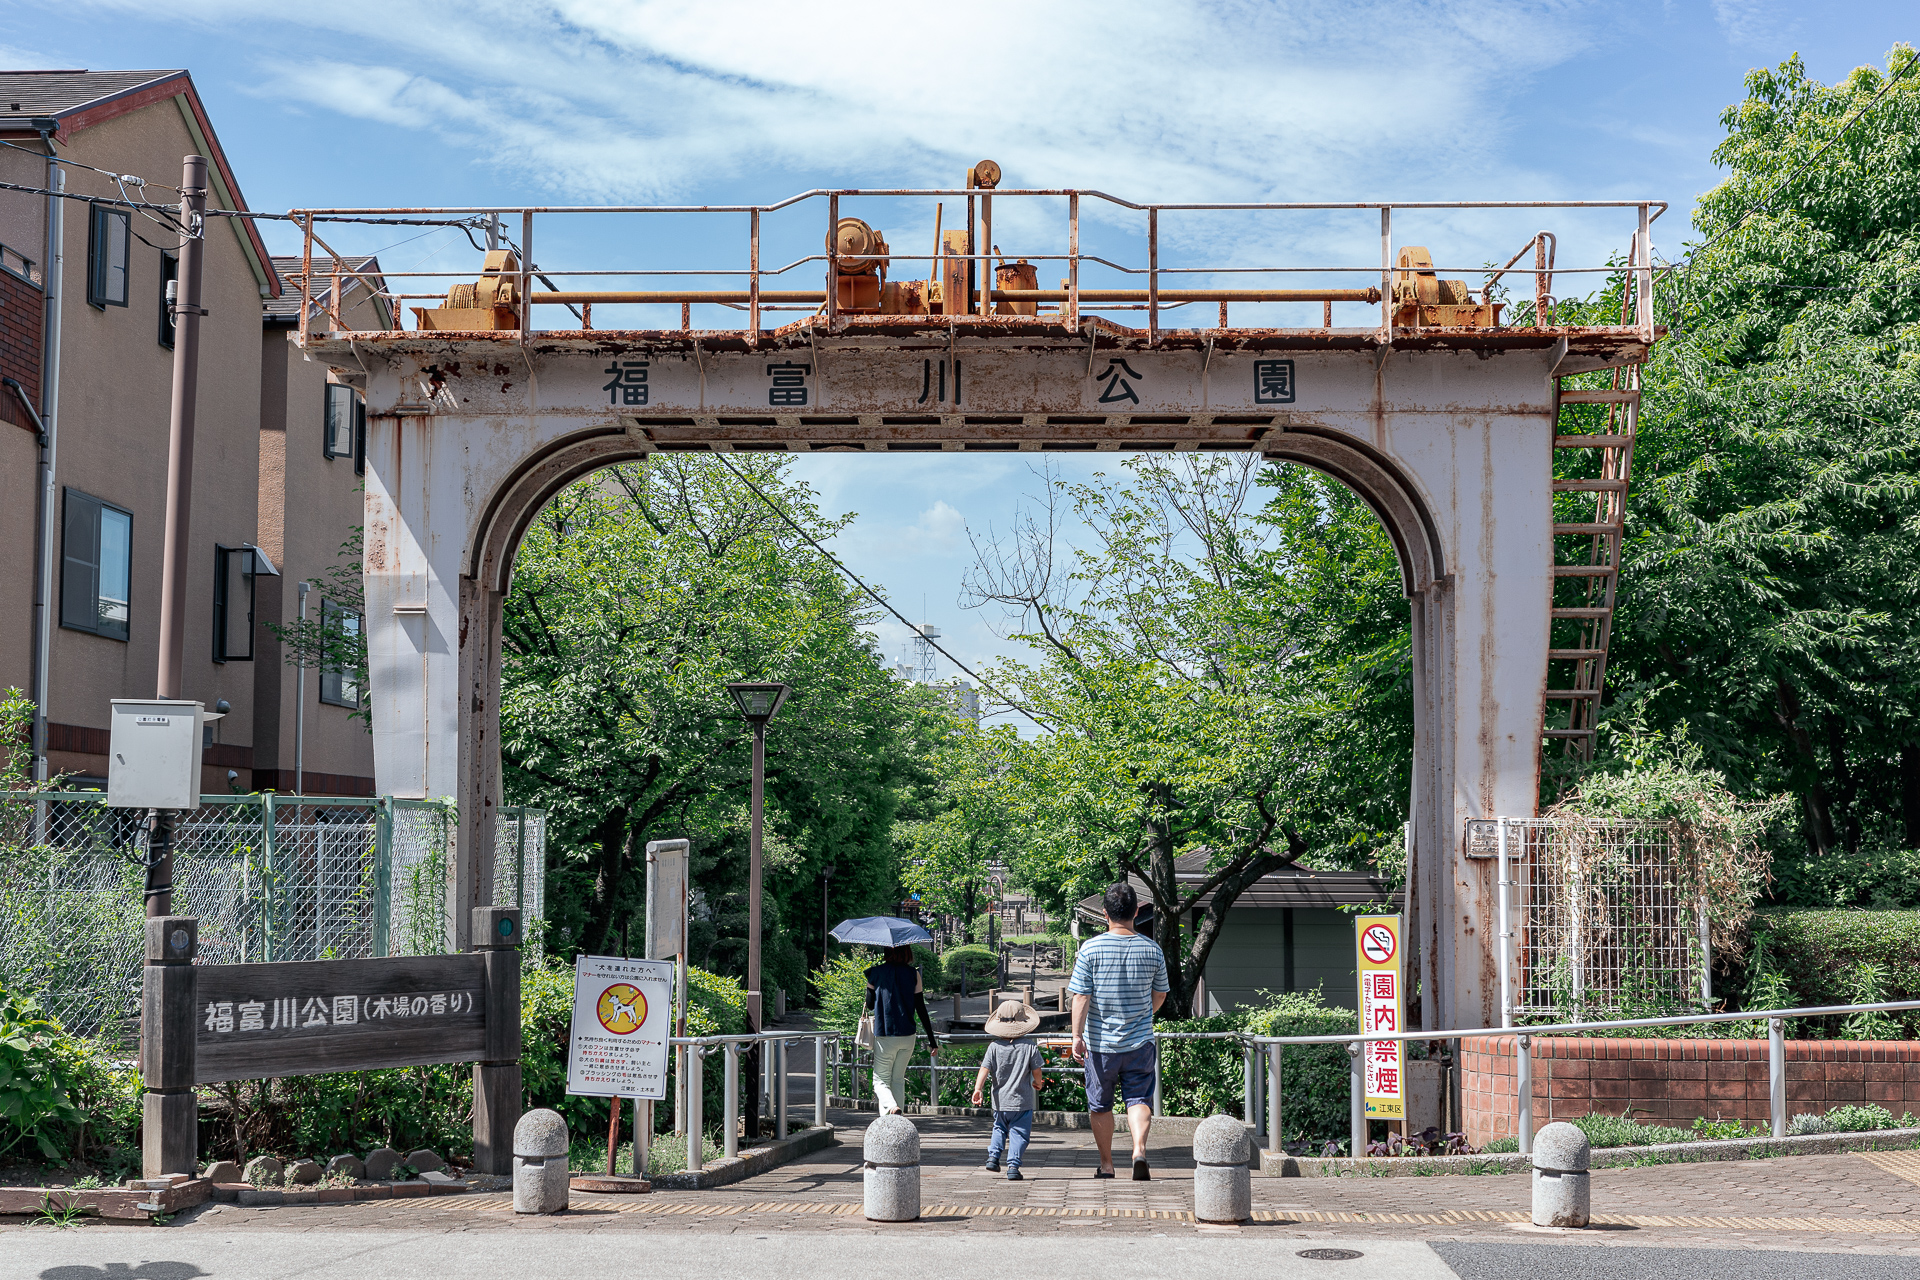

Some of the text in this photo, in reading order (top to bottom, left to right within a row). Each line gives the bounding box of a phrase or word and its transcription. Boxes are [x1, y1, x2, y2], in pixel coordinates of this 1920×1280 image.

[603, 359, 1296, 405] 福富川公園
[1373, 974, 1399, 1094] 園内禁煙
[1379, 1104, 1402, 1114] 江東区
